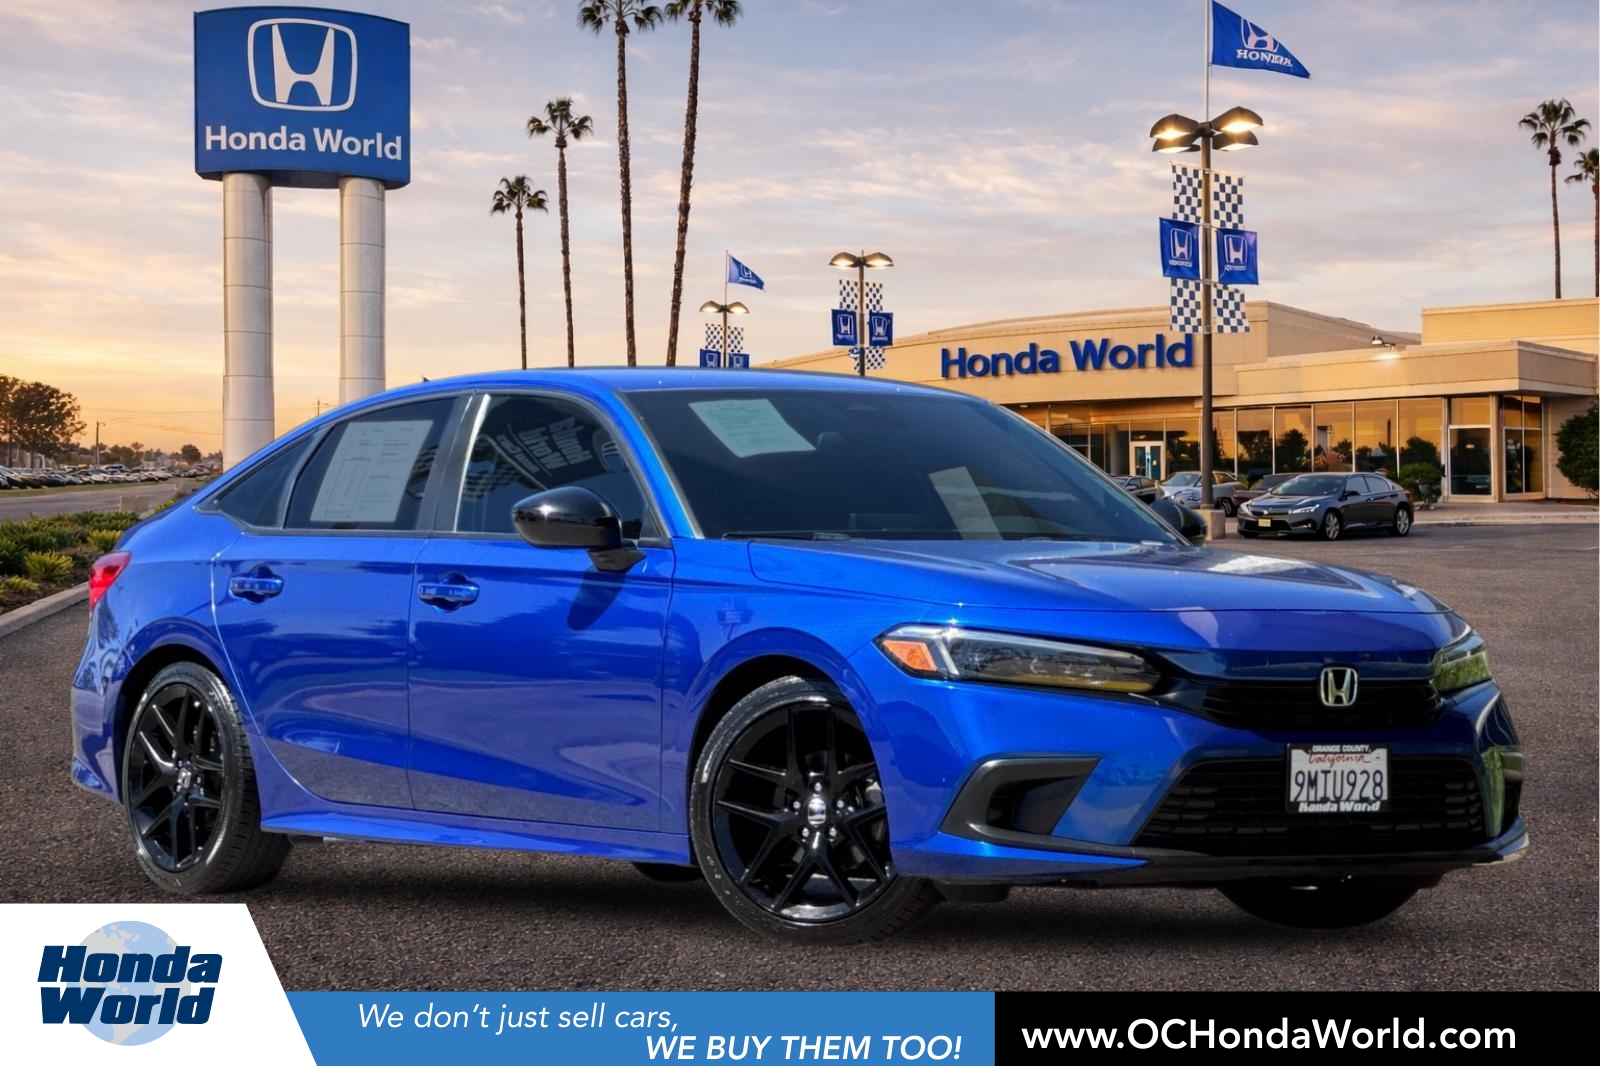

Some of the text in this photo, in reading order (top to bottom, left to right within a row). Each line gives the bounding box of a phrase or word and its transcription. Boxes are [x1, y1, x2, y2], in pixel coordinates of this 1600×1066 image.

[205, 125, 402, 161] Honda World
[941, 333, 1194, 378] Honda World
[1294, 769, 1384, 801] 9MIU928
